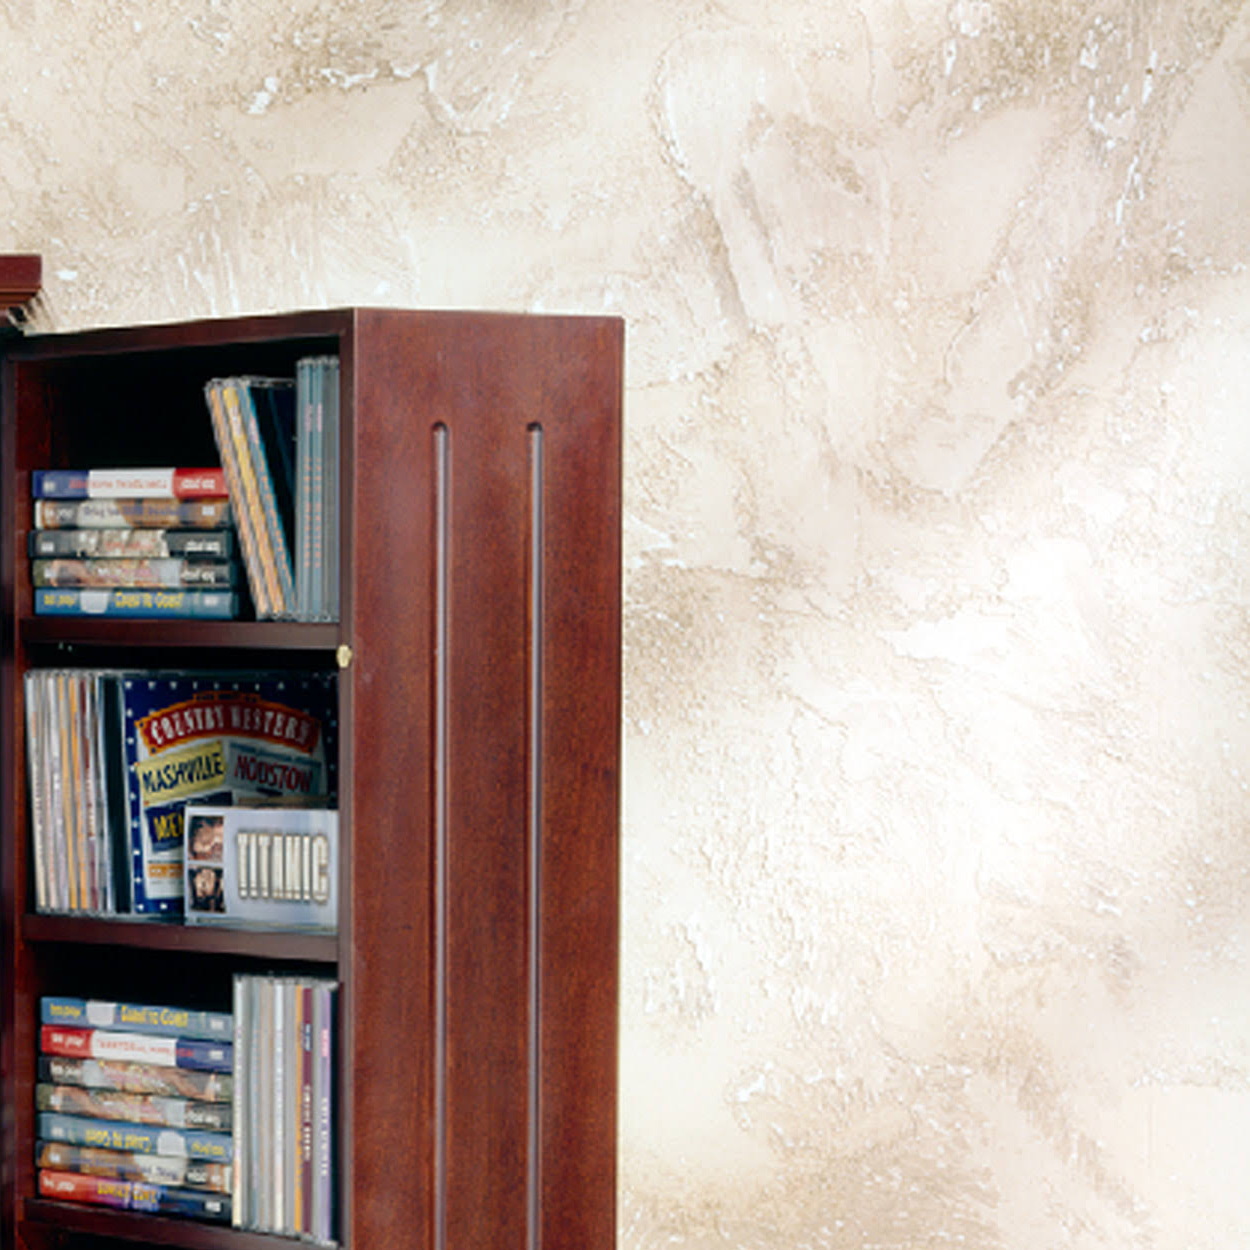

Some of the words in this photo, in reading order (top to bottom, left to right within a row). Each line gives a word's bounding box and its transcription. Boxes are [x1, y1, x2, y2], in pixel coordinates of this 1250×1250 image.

[142, 753, 224, 793] NASHVILLE
[234, 755, 313, 793] HOUSTON
[236, 829, 330, 903] TITANIC
